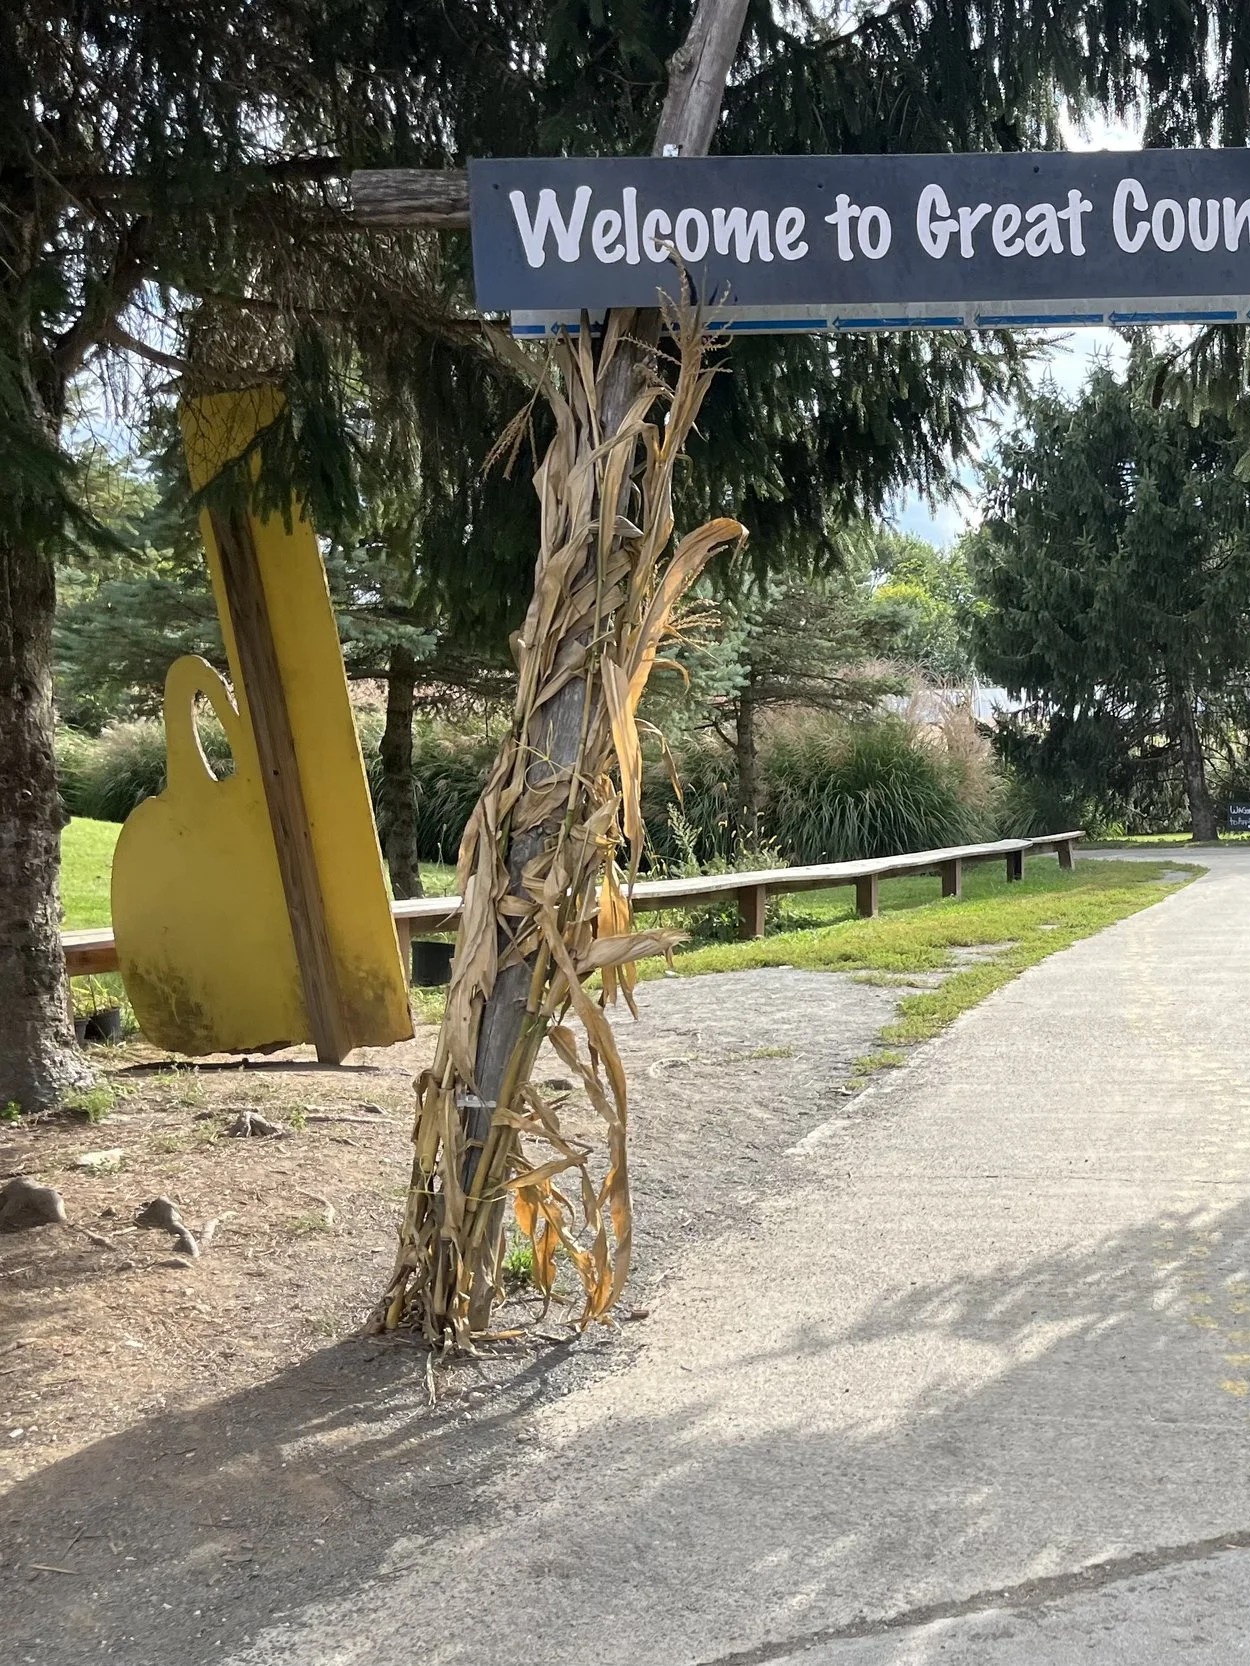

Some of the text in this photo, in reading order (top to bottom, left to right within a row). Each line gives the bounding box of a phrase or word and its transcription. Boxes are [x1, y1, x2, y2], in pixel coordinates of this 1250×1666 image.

[508, 185, 809, 268] Welcome
[824, 193, 892, 262] to
[916, 183, 1093, 259] Great
